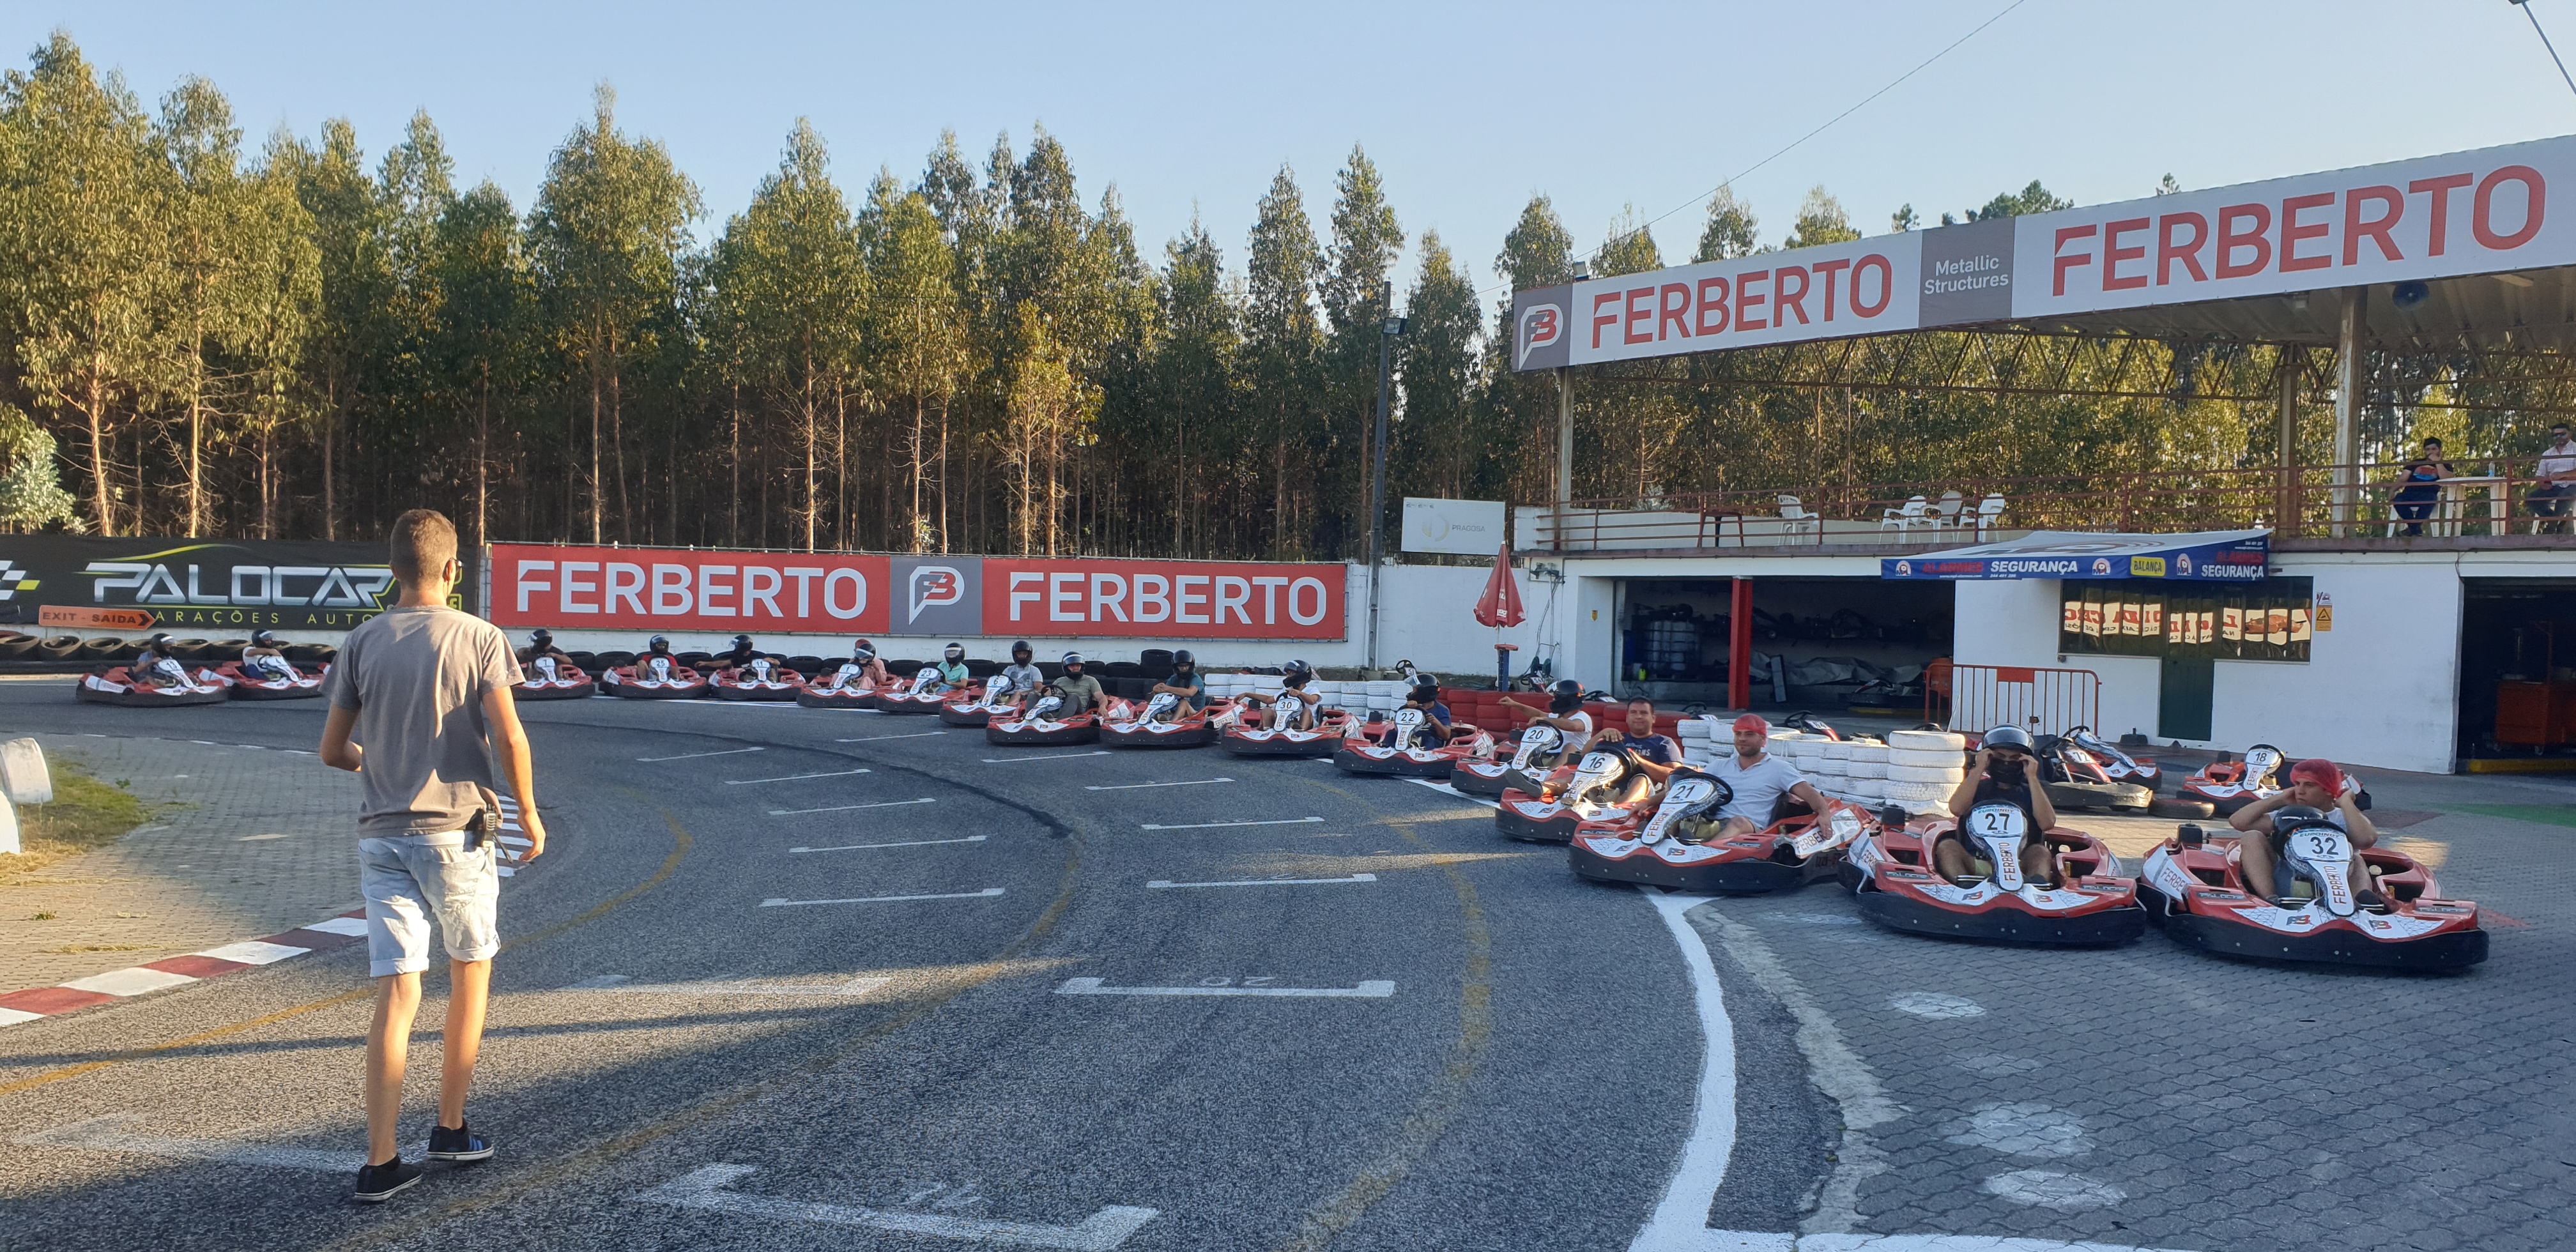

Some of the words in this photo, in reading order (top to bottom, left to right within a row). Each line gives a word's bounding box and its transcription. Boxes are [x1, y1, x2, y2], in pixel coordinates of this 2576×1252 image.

[2053, 165, 2546, 297] FERBERTO
[1935, 255, 1999, 277] Metallic
[1924, 273, 2009, 295] Structures
[1591, 254, 1892, 349] FERBERTO
[1920, 561, 1984, 574] ALARMES
[1990, 560, 2078, 576] SEGURANÇA
[2133, 560, 2163, 574] BALANÇA
[2202, 564, 2264, 581] SEGURANÇA
[85, 562, 392, 607] PALOCAR
[517, 560, 867, 620] FERBERTO
[1009, 571, 1328, 626] FERBERTO
[43, 612, 77, 622] EXIT
[91, 614, 137, 624] SAIDA
[994, 677, 999, 685] 6
[1401, 712, 1415, 722] 22
[1527, 729, 1544, 740] 20
[1589, 756, 1606, 769] 16
[2073, 751, 2090, 763] 72
[2255, 752, 2267, 762] 18
[1672, 784, 1696, 798] 21
[1984, 813, 2010, 831] 27
[2311, 836, 2339, 856] 32
[1998, 842, 2017, 882] FERBERTO
[2323, 866, 2347, 905] FERBERTO
